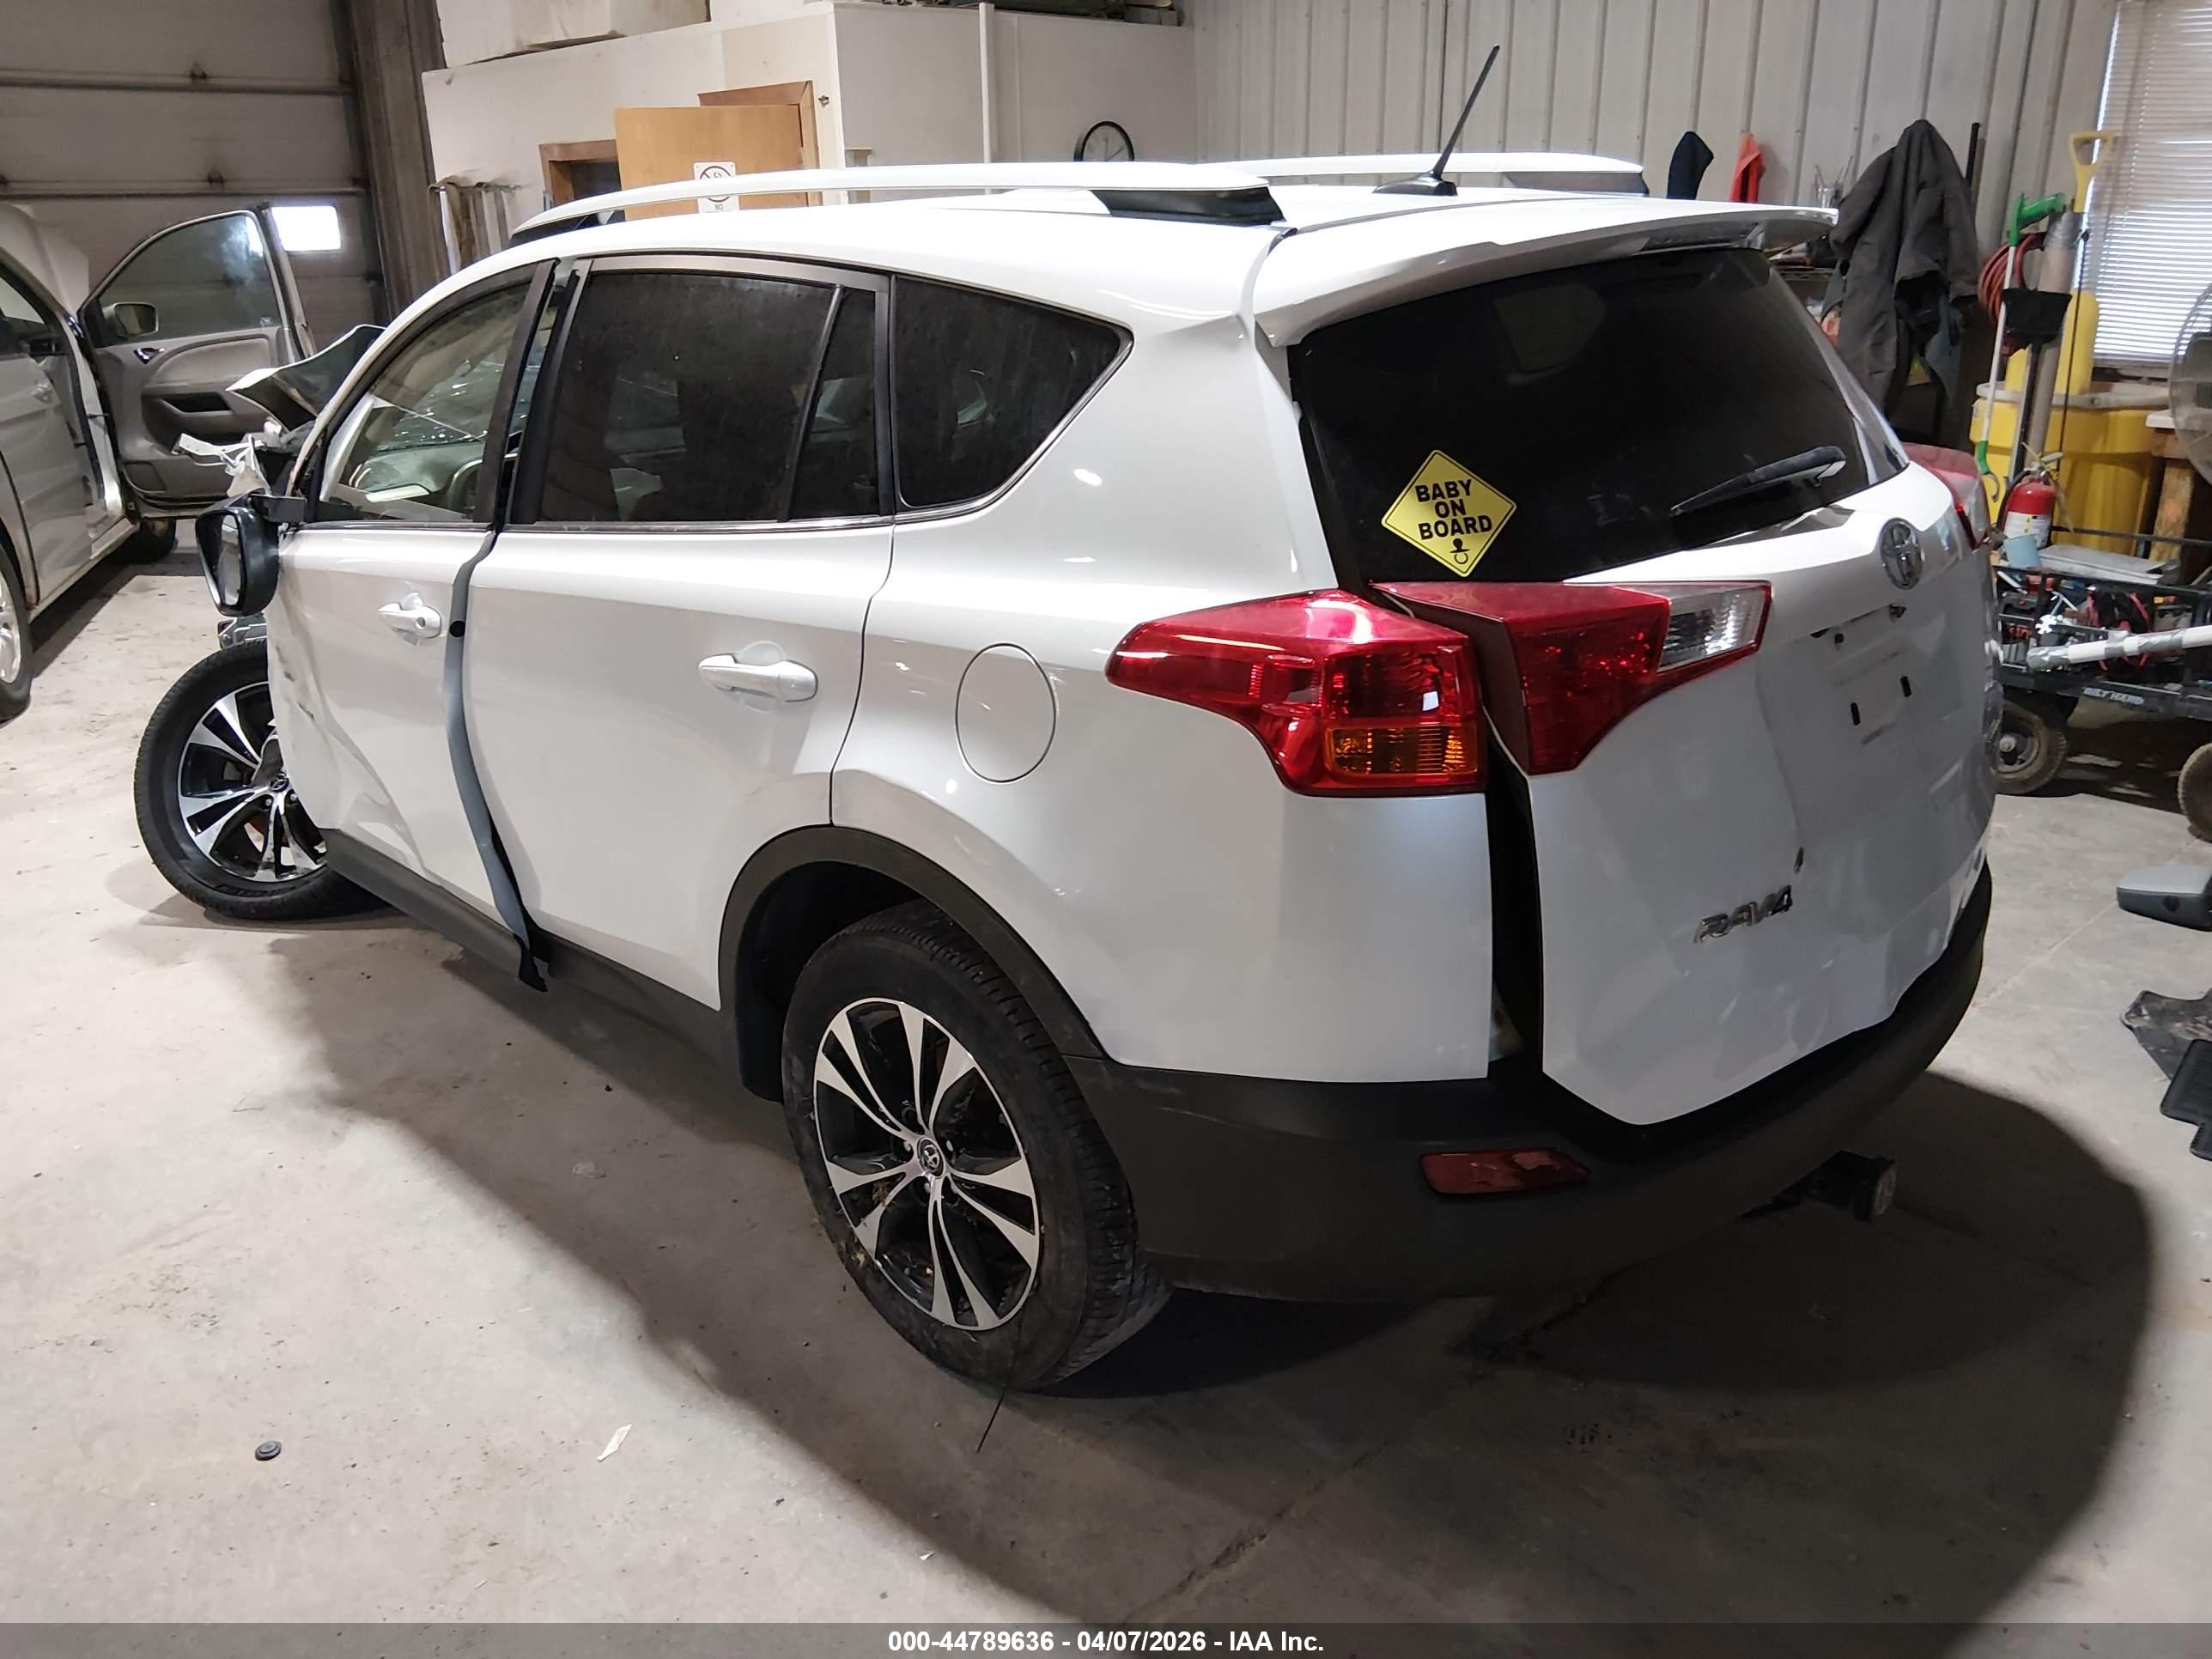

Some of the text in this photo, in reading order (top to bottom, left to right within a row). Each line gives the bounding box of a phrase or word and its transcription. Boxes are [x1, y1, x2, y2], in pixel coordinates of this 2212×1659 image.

[1415, 479, 1472, 502] BABY
[1434, 499, 1467, 518] ON
[1418, 515, 1492, 540] BOARD
[1693, 885, 1793, 943] RAV4
